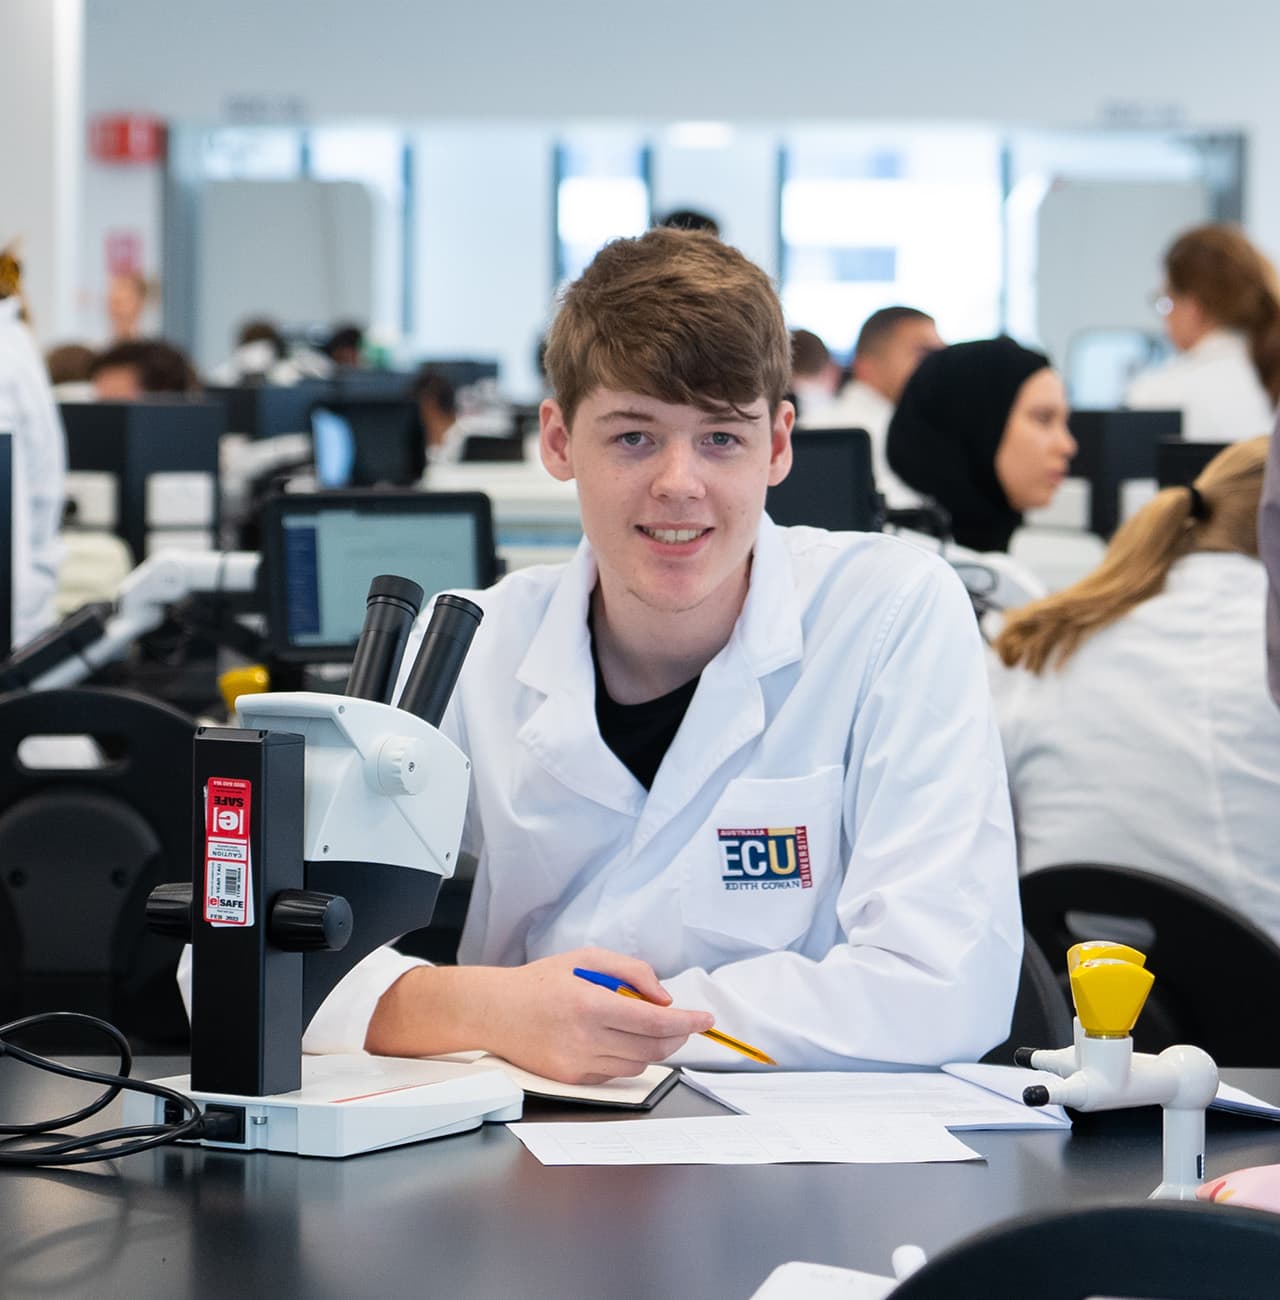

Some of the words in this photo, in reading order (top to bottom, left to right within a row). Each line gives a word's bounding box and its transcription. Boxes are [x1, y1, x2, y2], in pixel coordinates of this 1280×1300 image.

[214, 796, 244, 807] SAFE
[720, 829, 766, 837] AUSTRALIA
[212, 850, 243, 858] CAUTION
[719, 838, 797, 876] ECU
[796, 828, 812, 888] UNIVERSITY
[725, 881, 759, 890] EDITH
[761, 880, 800, 890] COWAN
[220, 899, 244, 909] SAFE
